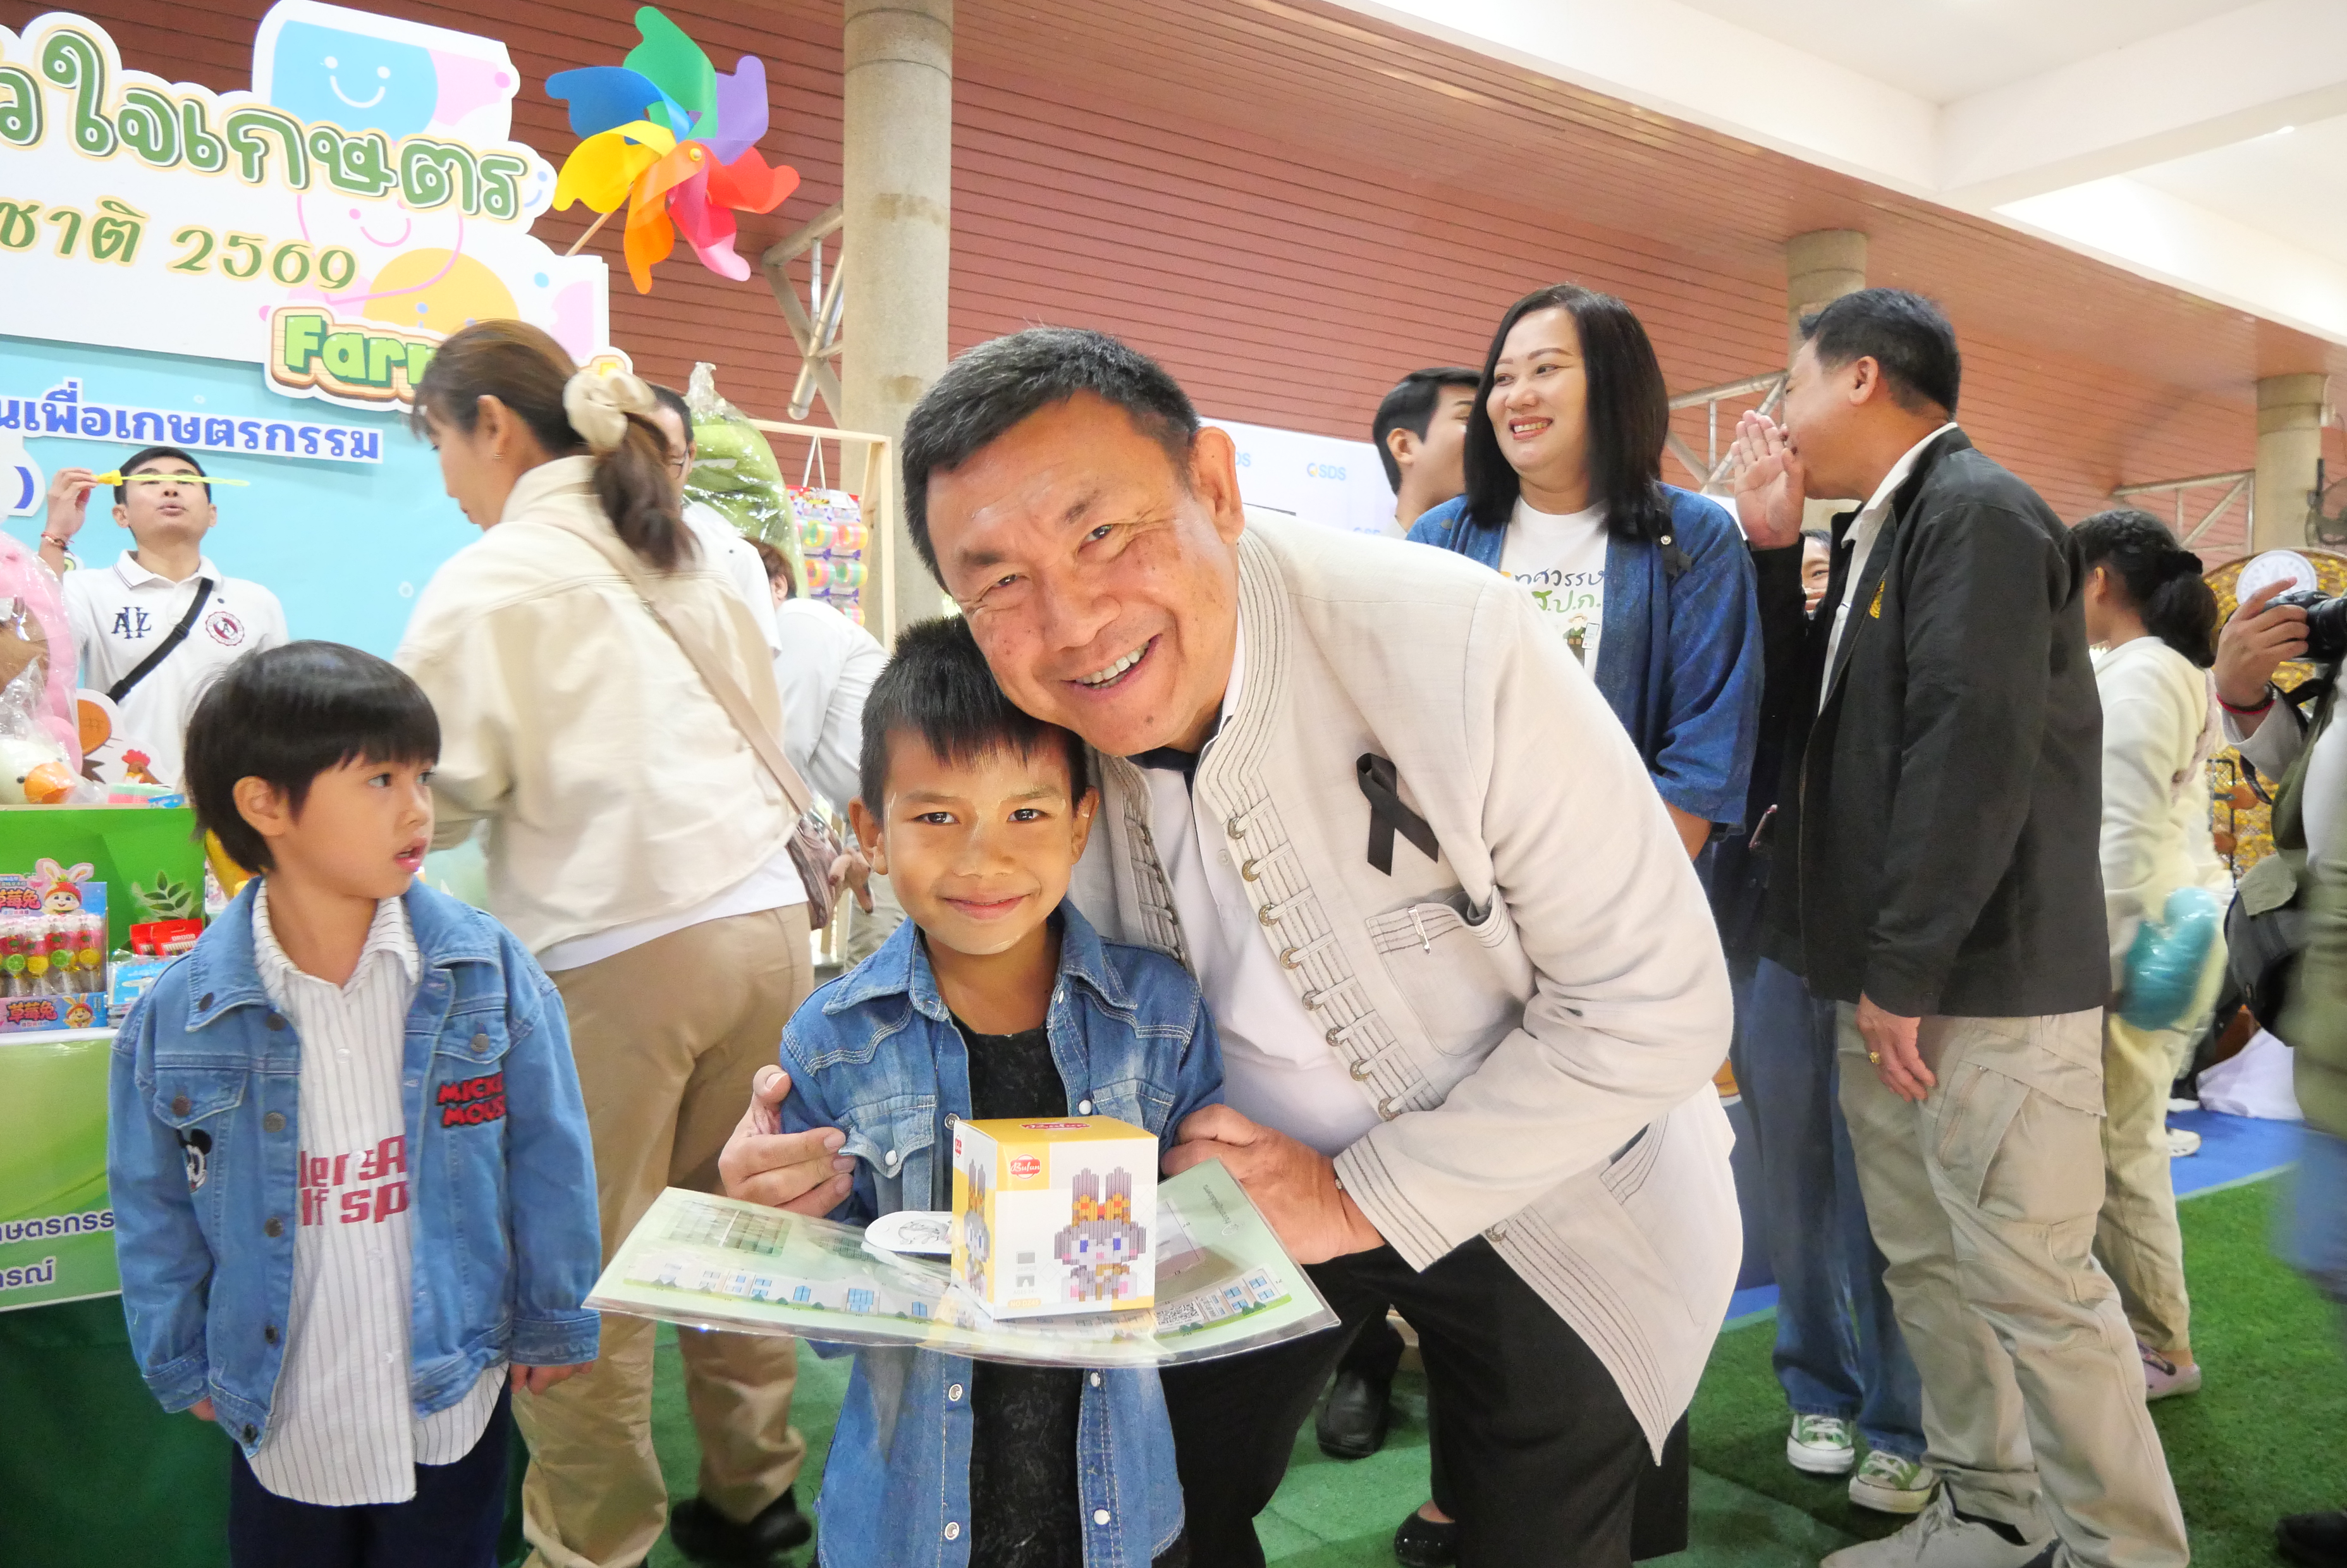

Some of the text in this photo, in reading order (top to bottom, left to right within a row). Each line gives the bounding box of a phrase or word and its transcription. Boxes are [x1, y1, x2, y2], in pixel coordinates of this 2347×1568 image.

[173, 230, 355, 289] 2569
[0, 1211, 114, 1241] ษตรกรร
[0, 1259, 52, 1288] รณ์
